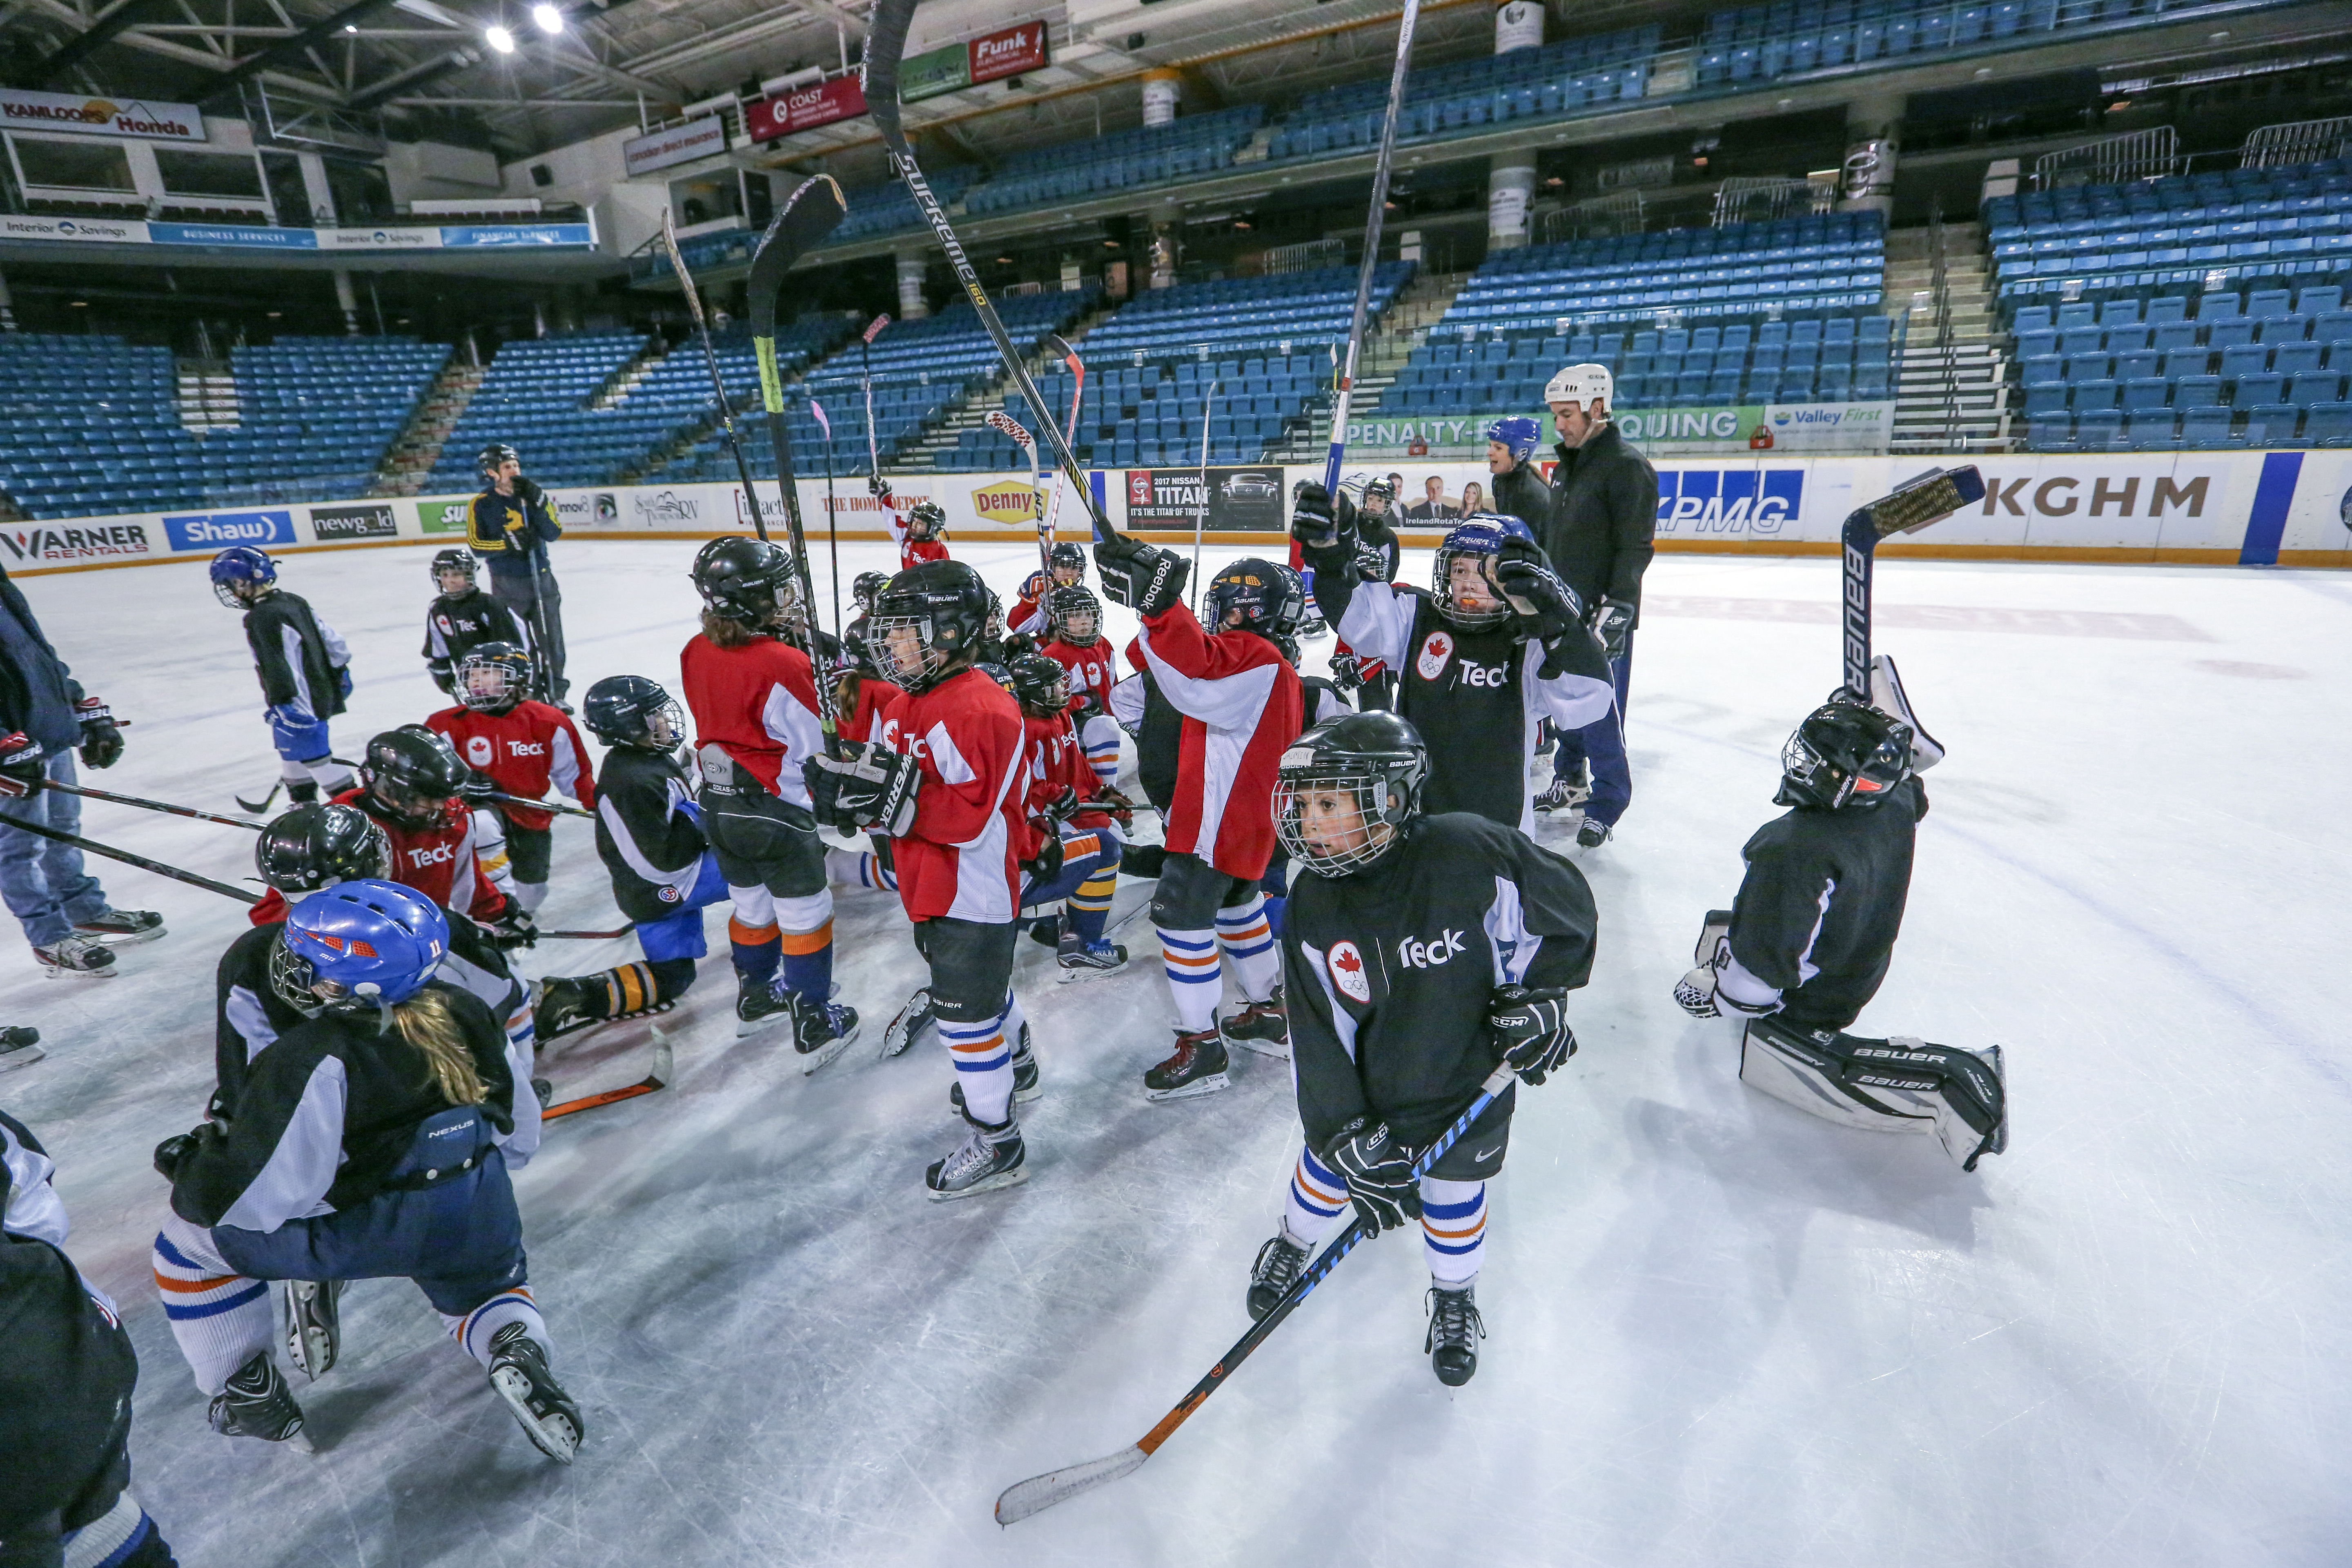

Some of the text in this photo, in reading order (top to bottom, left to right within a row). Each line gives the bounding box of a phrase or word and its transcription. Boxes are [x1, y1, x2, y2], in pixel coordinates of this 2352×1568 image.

[977, 31, 1026, 58] Funk
[790, 89, 822, 109] COAST
[116, 116, 190, 136] Honda
[7, 221, 127, 238] Interior Savings
[183, 229, 285, 242] BUSINESS SERVICES
[898, 154, 977, 281] SUPREME
[968, 283, 987, 306] 160
[1795, 408, 1882, 425] Valley First
[1172, 477, 1200, 485] NISSAN
[821, 497, 847, 511] THE
[850, 497, 881, 511] HOM
[977, 492, 1043, 513] Denny
[1154, 486, 1209, 505] TITAN
[1981, 476, 2210, 519] KGHM
[314, 508, 394, 533] newgold
[1130, 508, 1209, 516] IT'S THE TITAN OF TRUKS
[1405, 517, 1463, 525] IrelandRotaTe
[0, 525, 147, 560] WARNER
[1458, 536, 1489, 544] BAUER
[45, 543, 149, 559] RENTALS
[912, 552, 926, 563] Tec
[1140, 557, 1173, 610] Reebok
[456, 619, 477, 632] Tec
[1844, 543, 1865, 695] BAUER
[1459, 659, 1510, 687] Teck
[507, 740, 545, 757] Teck
[1389, 760, 1416, 768] BAUER
[1833, 775, 1853, 808] BAUER
[408, 841, 454, 869] Teck
[429, 939, 442, 958] 11
[1396, 929, 1467, 969] Teck
[1492, 1016, 1524, 1027] CCM
[1853, 1048, 1948, 1064] BAUER
[1858, 1074, 1936, 1090] BAUER
[428, 1119, 474, 1138] NEXUS
